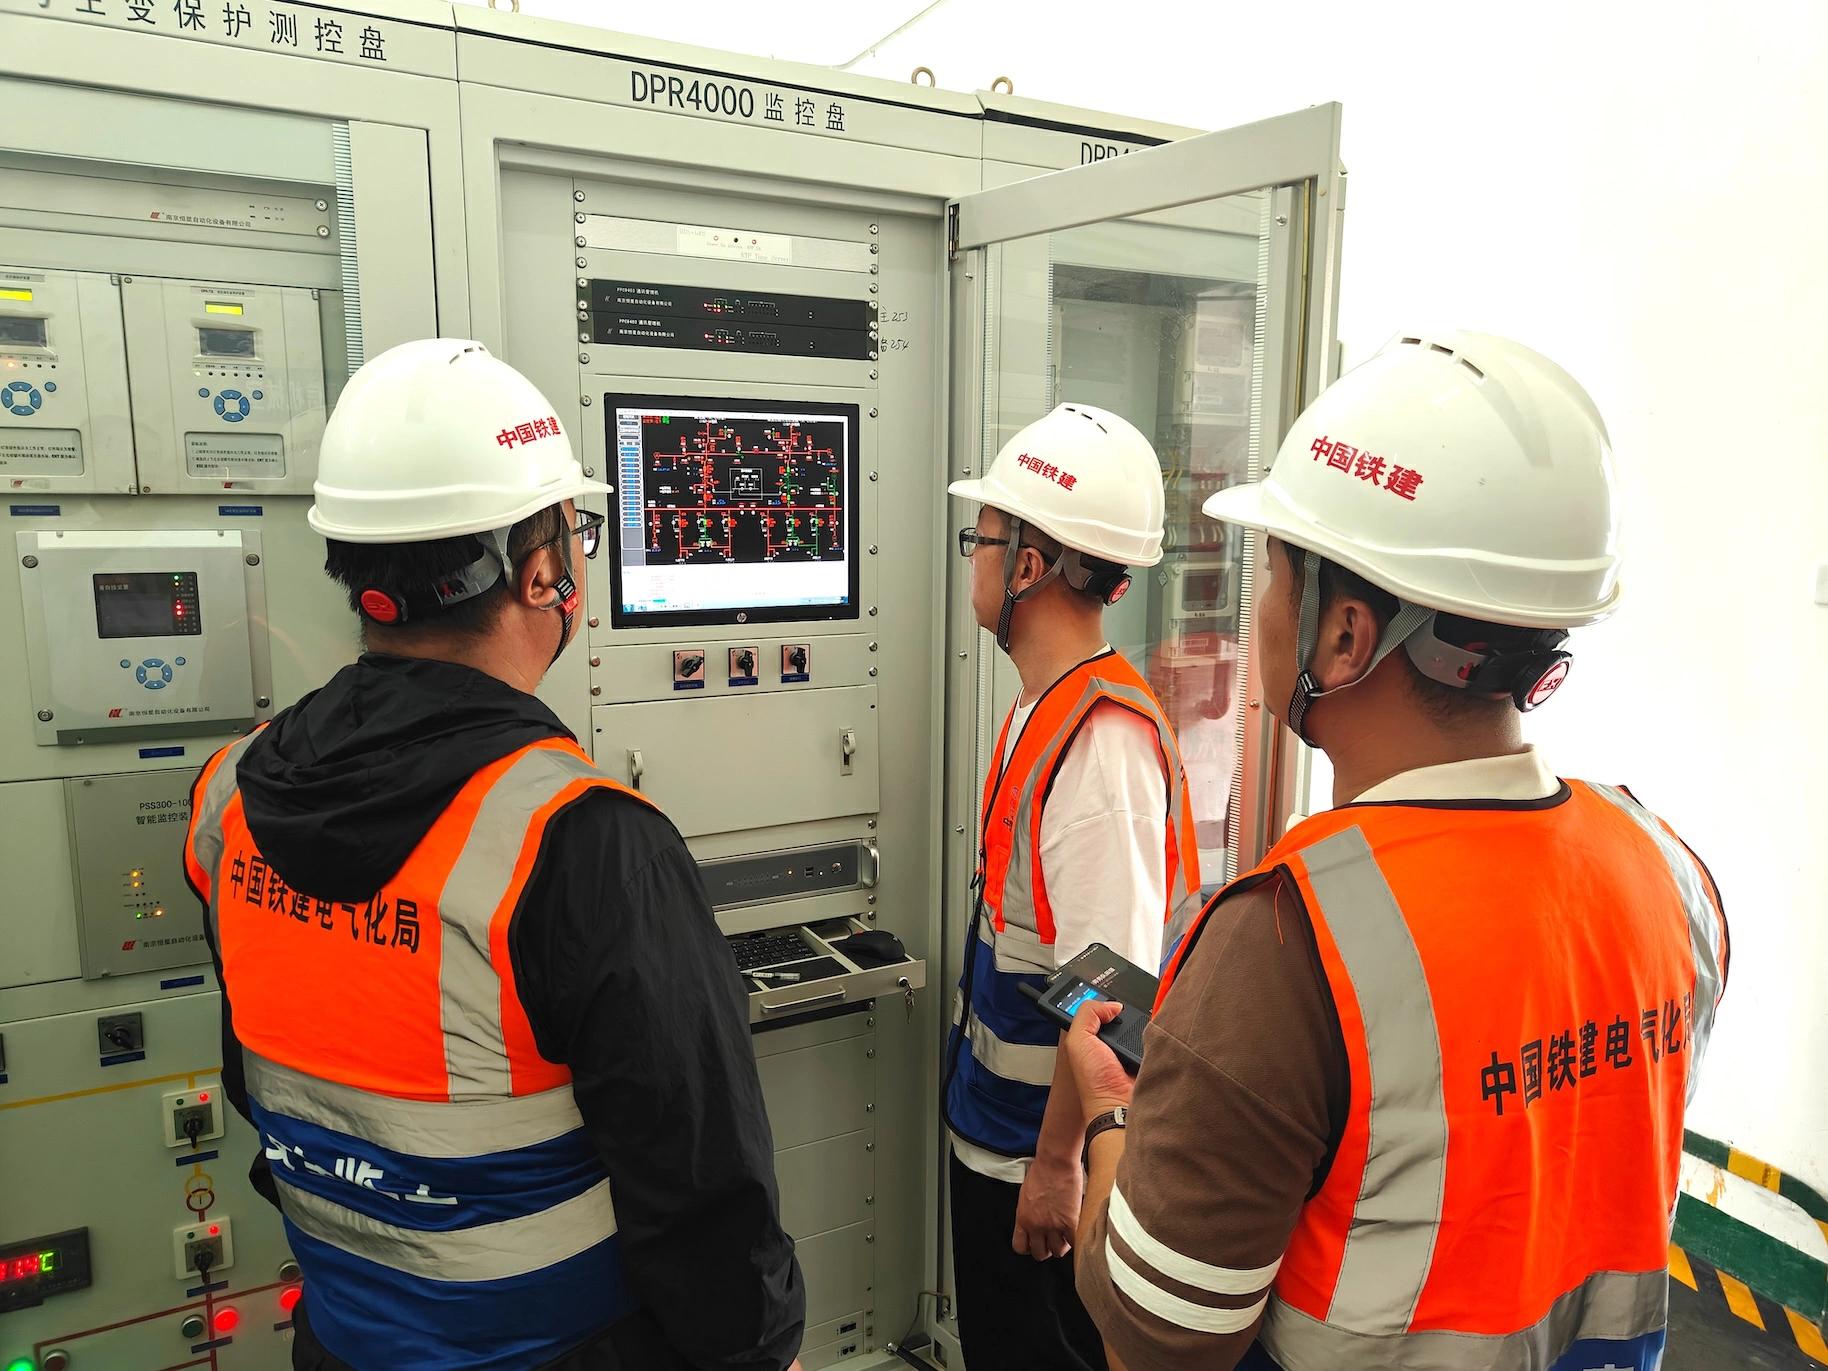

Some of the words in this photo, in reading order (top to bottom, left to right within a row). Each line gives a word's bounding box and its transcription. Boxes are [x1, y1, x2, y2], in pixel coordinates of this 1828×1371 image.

[39, 0, 388, 61] 变保护测控盘
[631, 71, 754, 118] DPR4000
[764, 92, 845, 131] 监控盘
[496, 416, 561, 449] 中国铁建
[1017, 453, 1077, 491] 中国铁建
[1310, 435, 1424, 501] 中国铁建
[230, 850, 420, 954] 中国铁建电气化局
[1481, 991, 1690, 1116] 中国铁建电气化局
